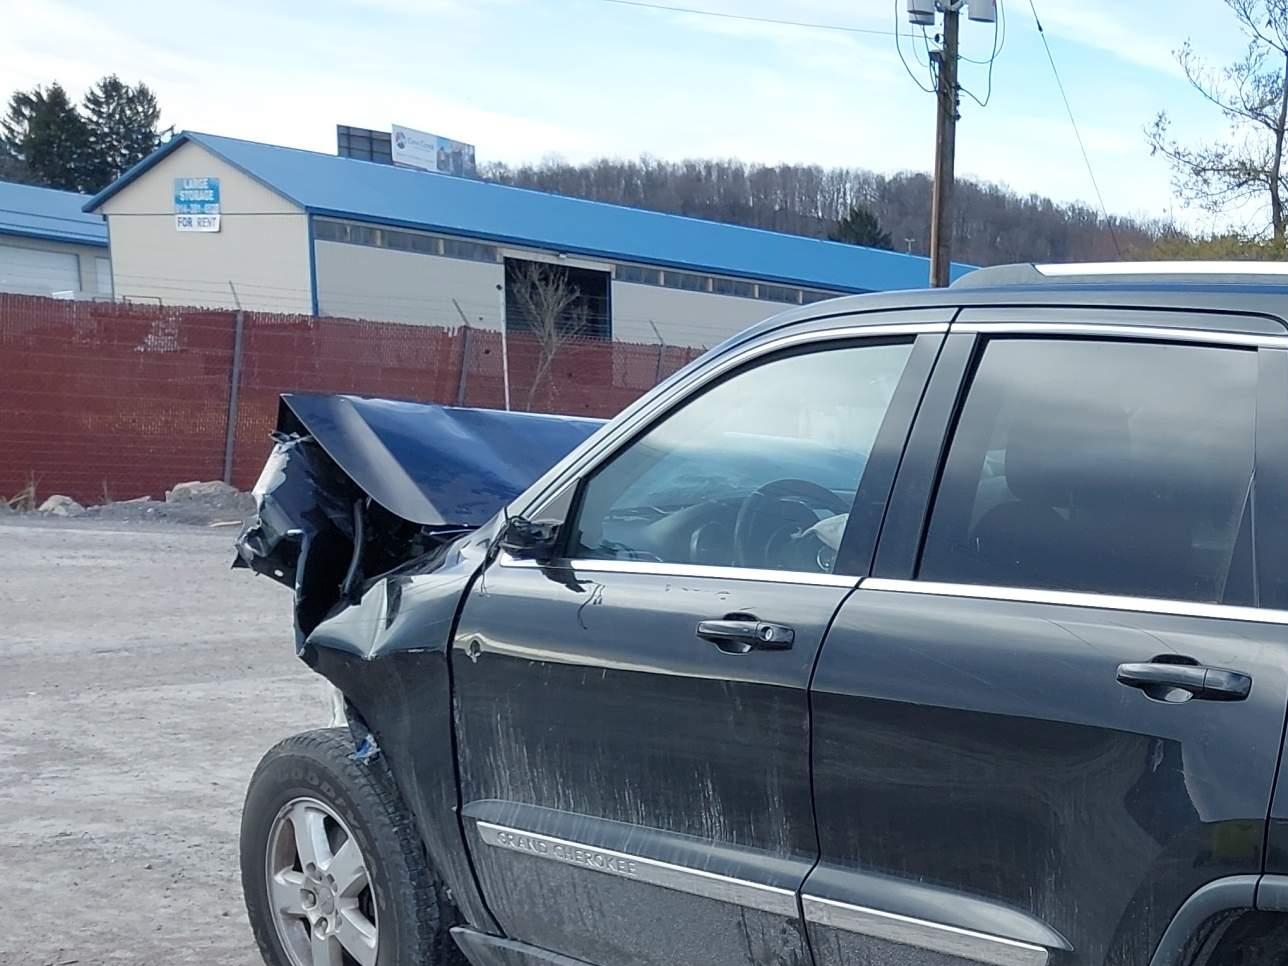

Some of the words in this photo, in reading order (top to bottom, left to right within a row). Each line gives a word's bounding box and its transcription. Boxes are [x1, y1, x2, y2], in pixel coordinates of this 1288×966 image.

[180, 190, 214, 201] STORAGE
[177, 216, 193, 227] FOR
[197, 216, 217, 227] RENT
[497, 831, 547, 855] GRAND
[552, 844, 637, 877] CHEROKEE
